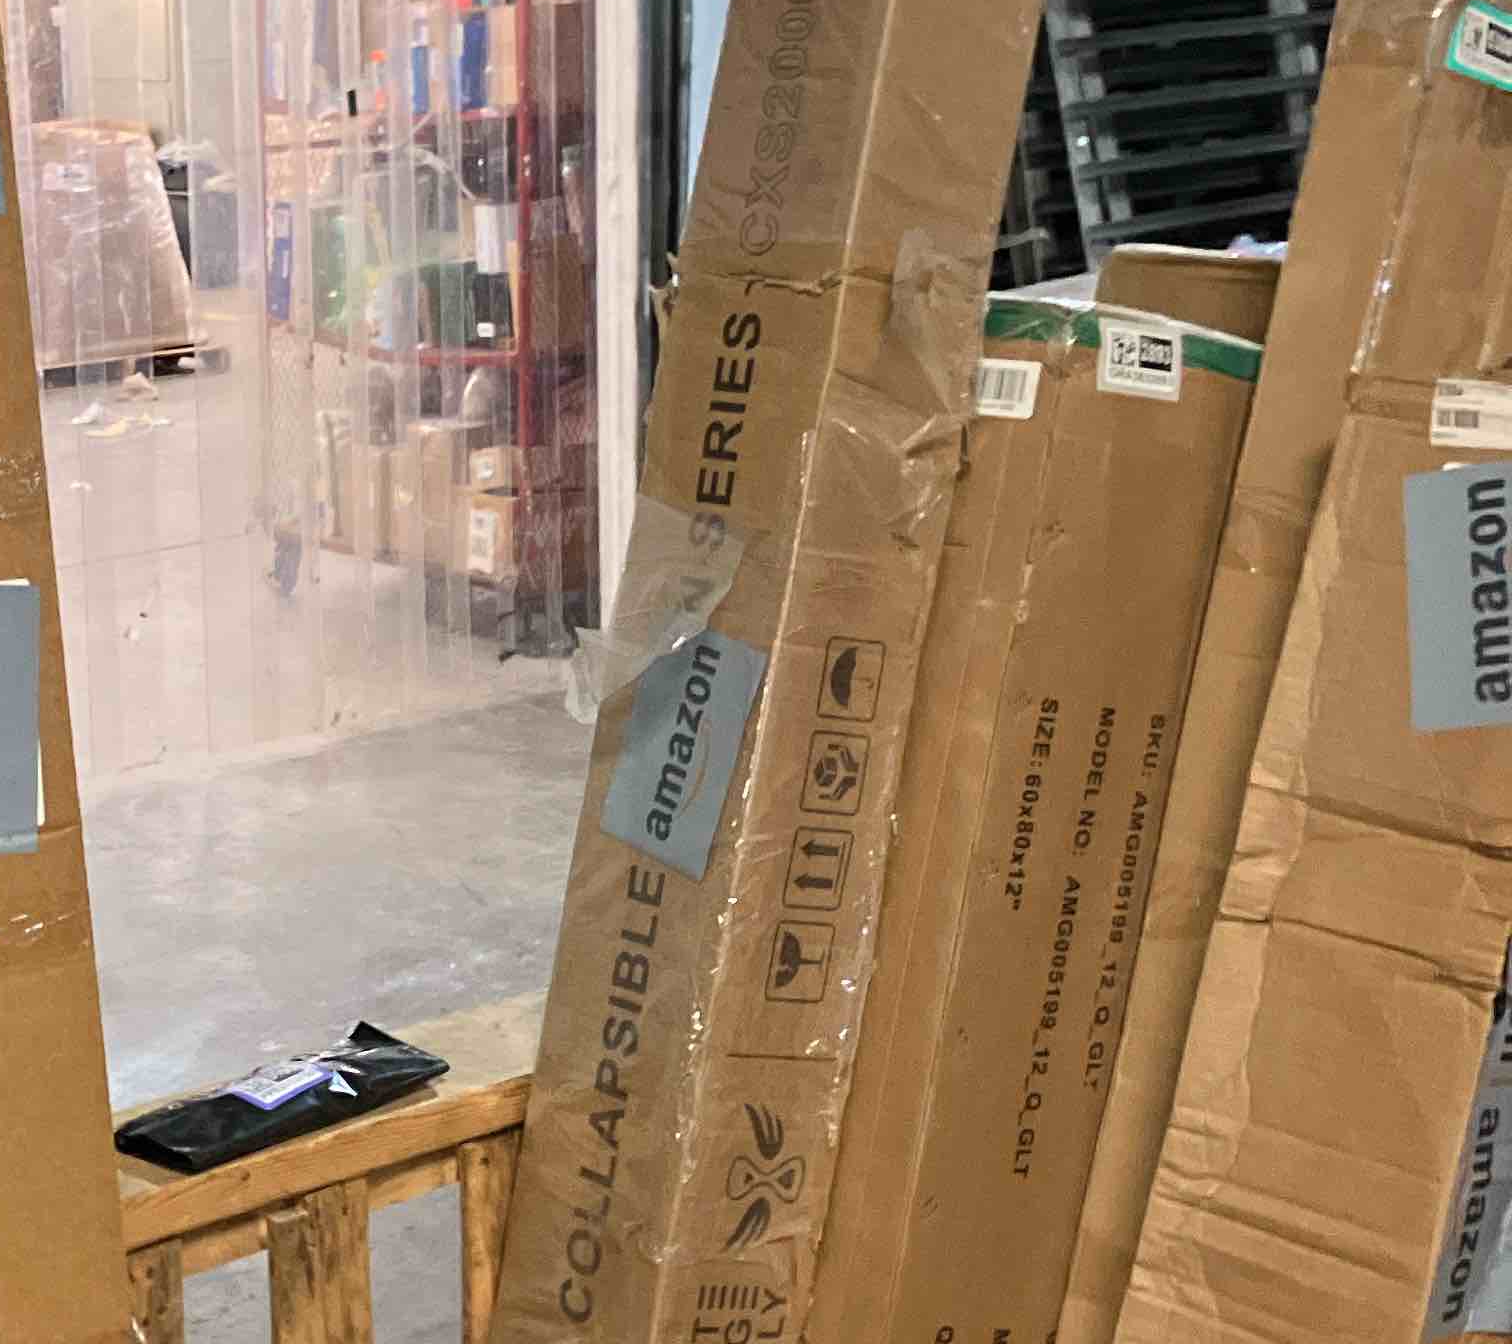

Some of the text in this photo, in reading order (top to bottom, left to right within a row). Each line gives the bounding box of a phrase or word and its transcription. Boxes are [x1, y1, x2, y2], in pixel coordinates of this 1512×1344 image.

[1468, 479, 1510, 702] amazon
[559, 864, 665, 1323] COLLAPSIBLE
[690, 310, 762, 548] SERIES
[645, 642, 721, 842] amazon
[1084, 706, 1116, 802] MODEL
[1442, 1106, 1499, 1322] amazon
